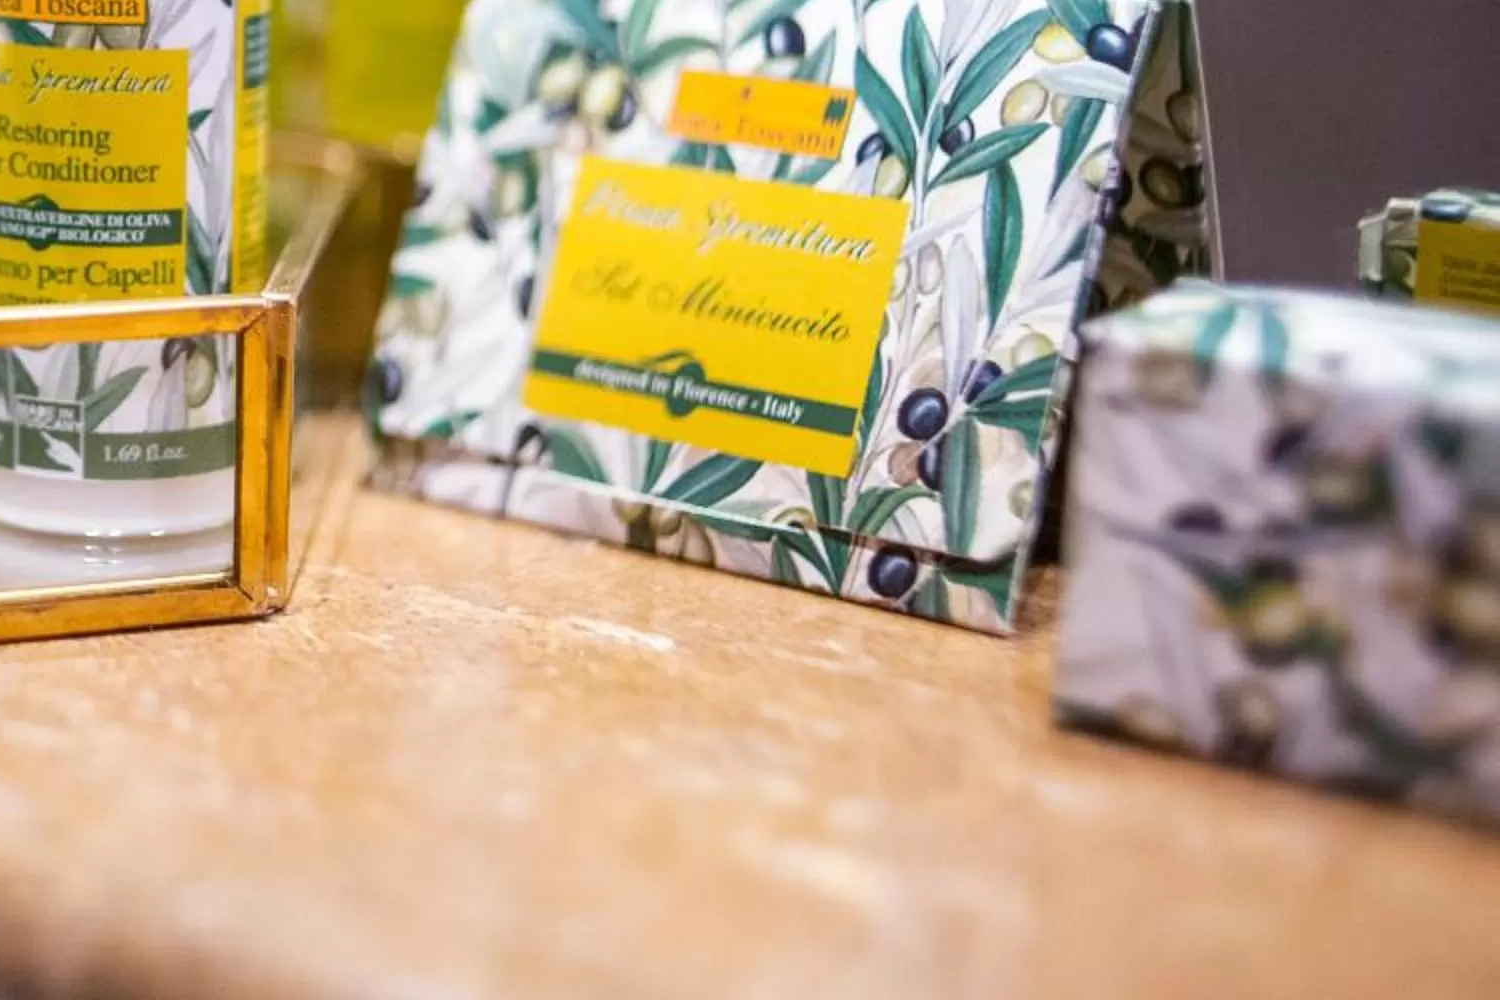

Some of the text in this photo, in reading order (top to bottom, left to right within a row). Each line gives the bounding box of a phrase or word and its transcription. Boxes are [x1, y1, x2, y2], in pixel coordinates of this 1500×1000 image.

[24, 57, 174, 104] Spremitura
[8, 152, 161, 184] Conditioner
[58, 228, 146, 243] BIOLOGICO
[107, 213, 124, 227] DI
[126, 212, 172, 228] OLIVA
[37, 264, 78, 290] per
[83, 259, 176, 294] Capelli
[650, 372, 671, 395] in
[672, 376, 750, 411] Florence
[761, 395, 805, 424] Italy
[103, 444, 142, 463] 1.69
